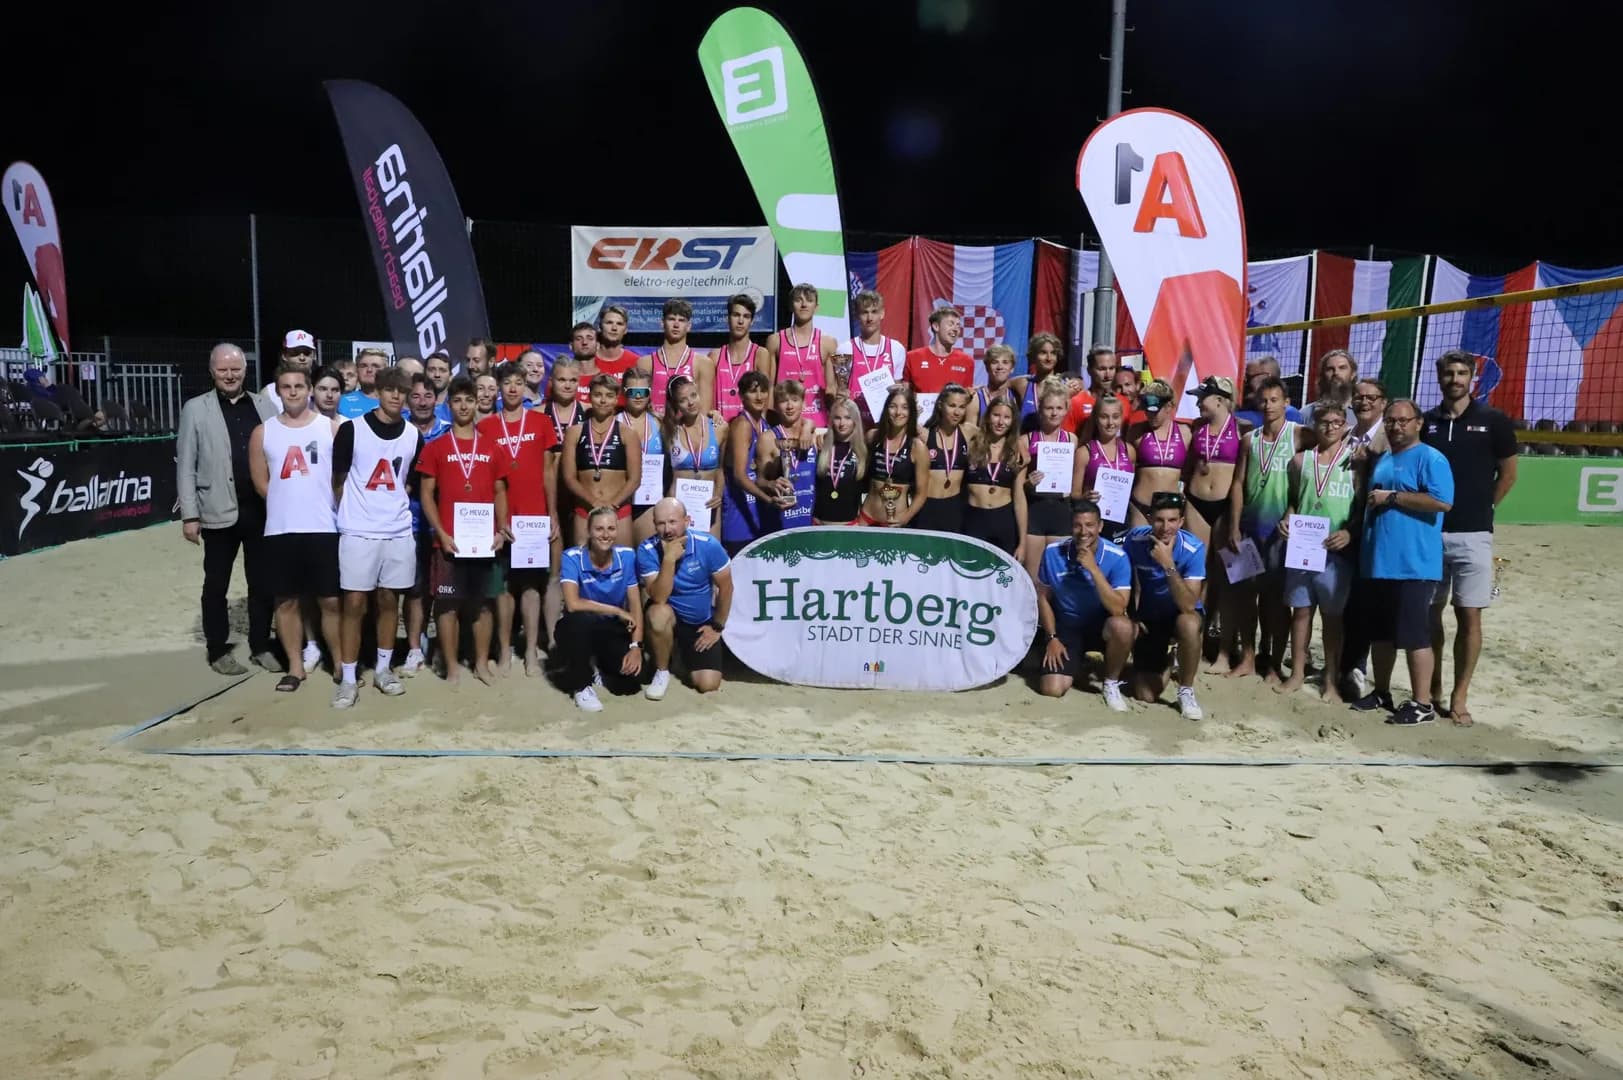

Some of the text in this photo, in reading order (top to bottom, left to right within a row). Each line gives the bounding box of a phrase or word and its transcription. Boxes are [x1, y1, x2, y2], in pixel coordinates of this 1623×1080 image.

[624, 275, 749, 289] elektro-regeltechnik.at
[683, 364, 692, 375] 2
[280, 439, 319, 480] A1
[364, 456, 404, 492] A1
[46, 470, 153, 515] ballarina
[1328, 480, 1351, 498] SLO
[469, 508, 490, 517] MEVZA
[525, 521, 547, 529] MEVZA
[1304, 522, 1326, 530] MEVZA
[752, 577, 1003, 647] Hartberg
[807, 625, 963, 651] STADT DER SINNE
